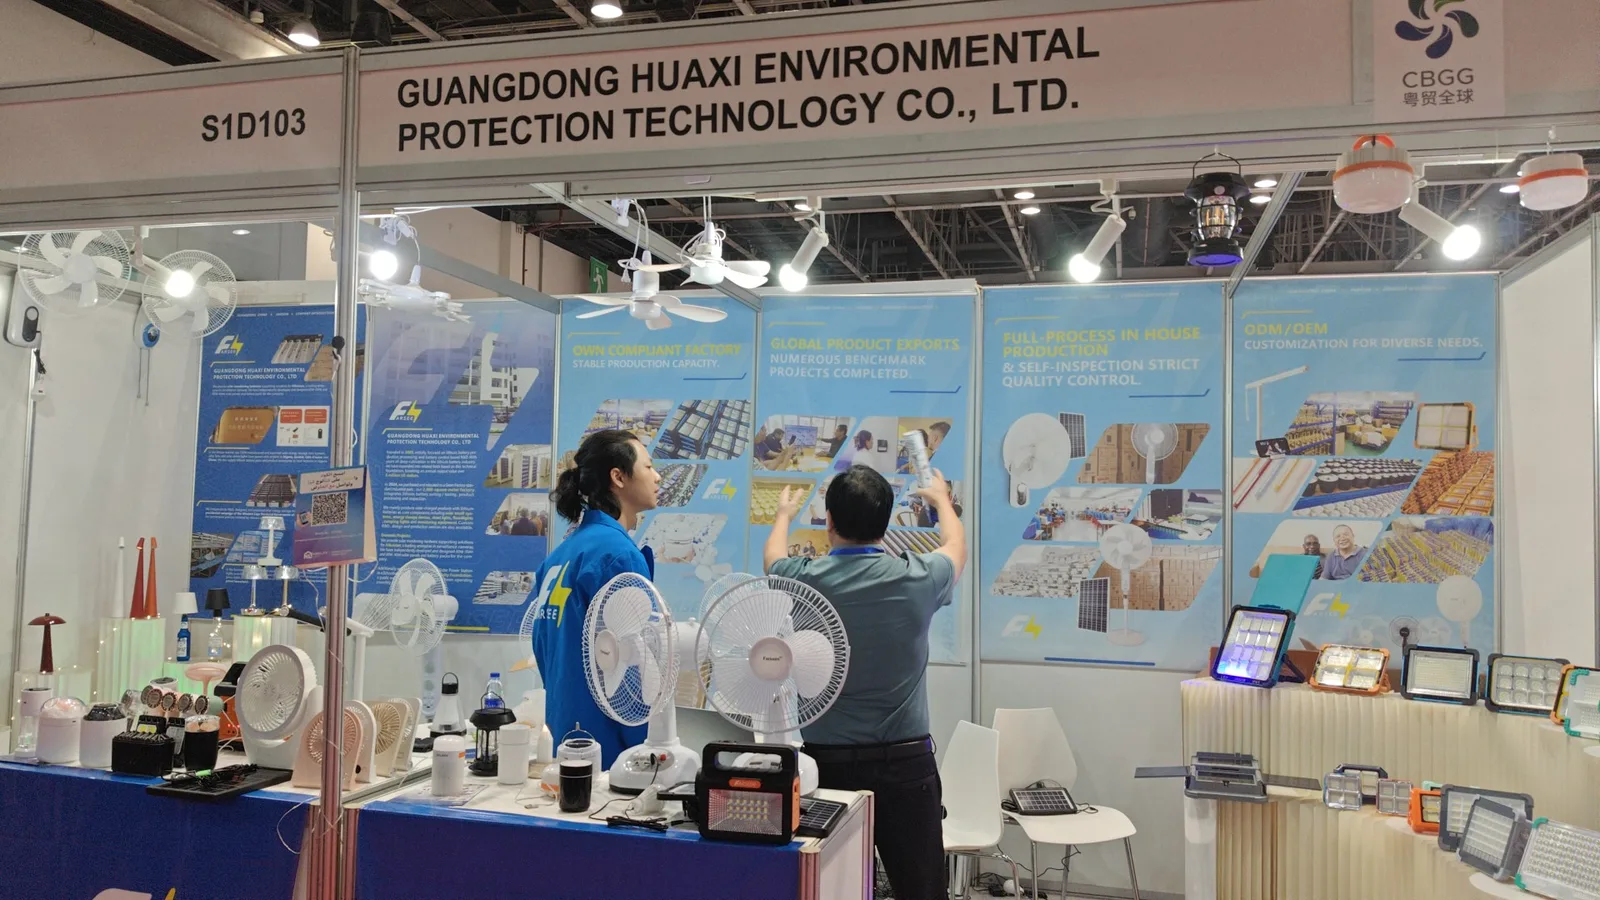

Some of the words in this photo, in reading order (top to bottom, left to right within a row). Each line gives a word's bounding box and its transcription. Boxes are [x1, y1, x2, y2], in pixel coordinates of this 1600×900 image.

[397, 65, 619, 108] GUANGDONG
[631, 55, 741, 93] HUAXI
[754, 26, 1100, 85] ENVIRONMENTAL
[1402, 67, 1474, 88] CBGG
[1402, 88, 1474, 107] 粤贸全球
[398, 110, 614, 152] PROTECTION
[623, 91, 885, 138] TECHNOLOGY
[896, 86, 977, 123] CO.,
[992, 77, 1079, 115] LTD.
[201, 108, 306, 142] S1D103
[1121, 328, 1139, 341] IN
[1144, 327, 1201, 341] HOUSE
[572, 344, 605, 357] OWN
[608, 344, 682, 357] COMPLIANT
[685, 343, 742, 356] FACTORY
[770, 337, 823, 350] GLOBAL
[827, 338, 892, 351] PRODUCT
[896, 338, 961, 351] EXPORTS
[1244, 339, 1348, 350] CUSTOMIZATION
[1353, 338, 1378, 348] FOR
[1381, 337, 1433, 348] DIVERSE
[1438, 337, 1483, 348] NEEDS.
[1003, 344, 1109, 358] PRODUCTION
[572, 359, 606, 368] STABLE
[608, 359, 670, 368] PRODUCTION
[672, 359, 720, 369] CAPACITY.
[770, 354, 841, 365] NUMEROUS
[845, 354, 926, 365] BENCHMARK
[1002, 362, 1014, 373] &
[1019, 359, 1144, 373] SELF-INSPECTION
[1148, 358, 1200, 370] STRICT
[770, 367, 829, 378] PROJECTS
[833, 367, 912, 379] COMPLETED.
[1002, 375, 1063, 388] QUALITY
[1067, 374, 1142, 387] CONTROL.
